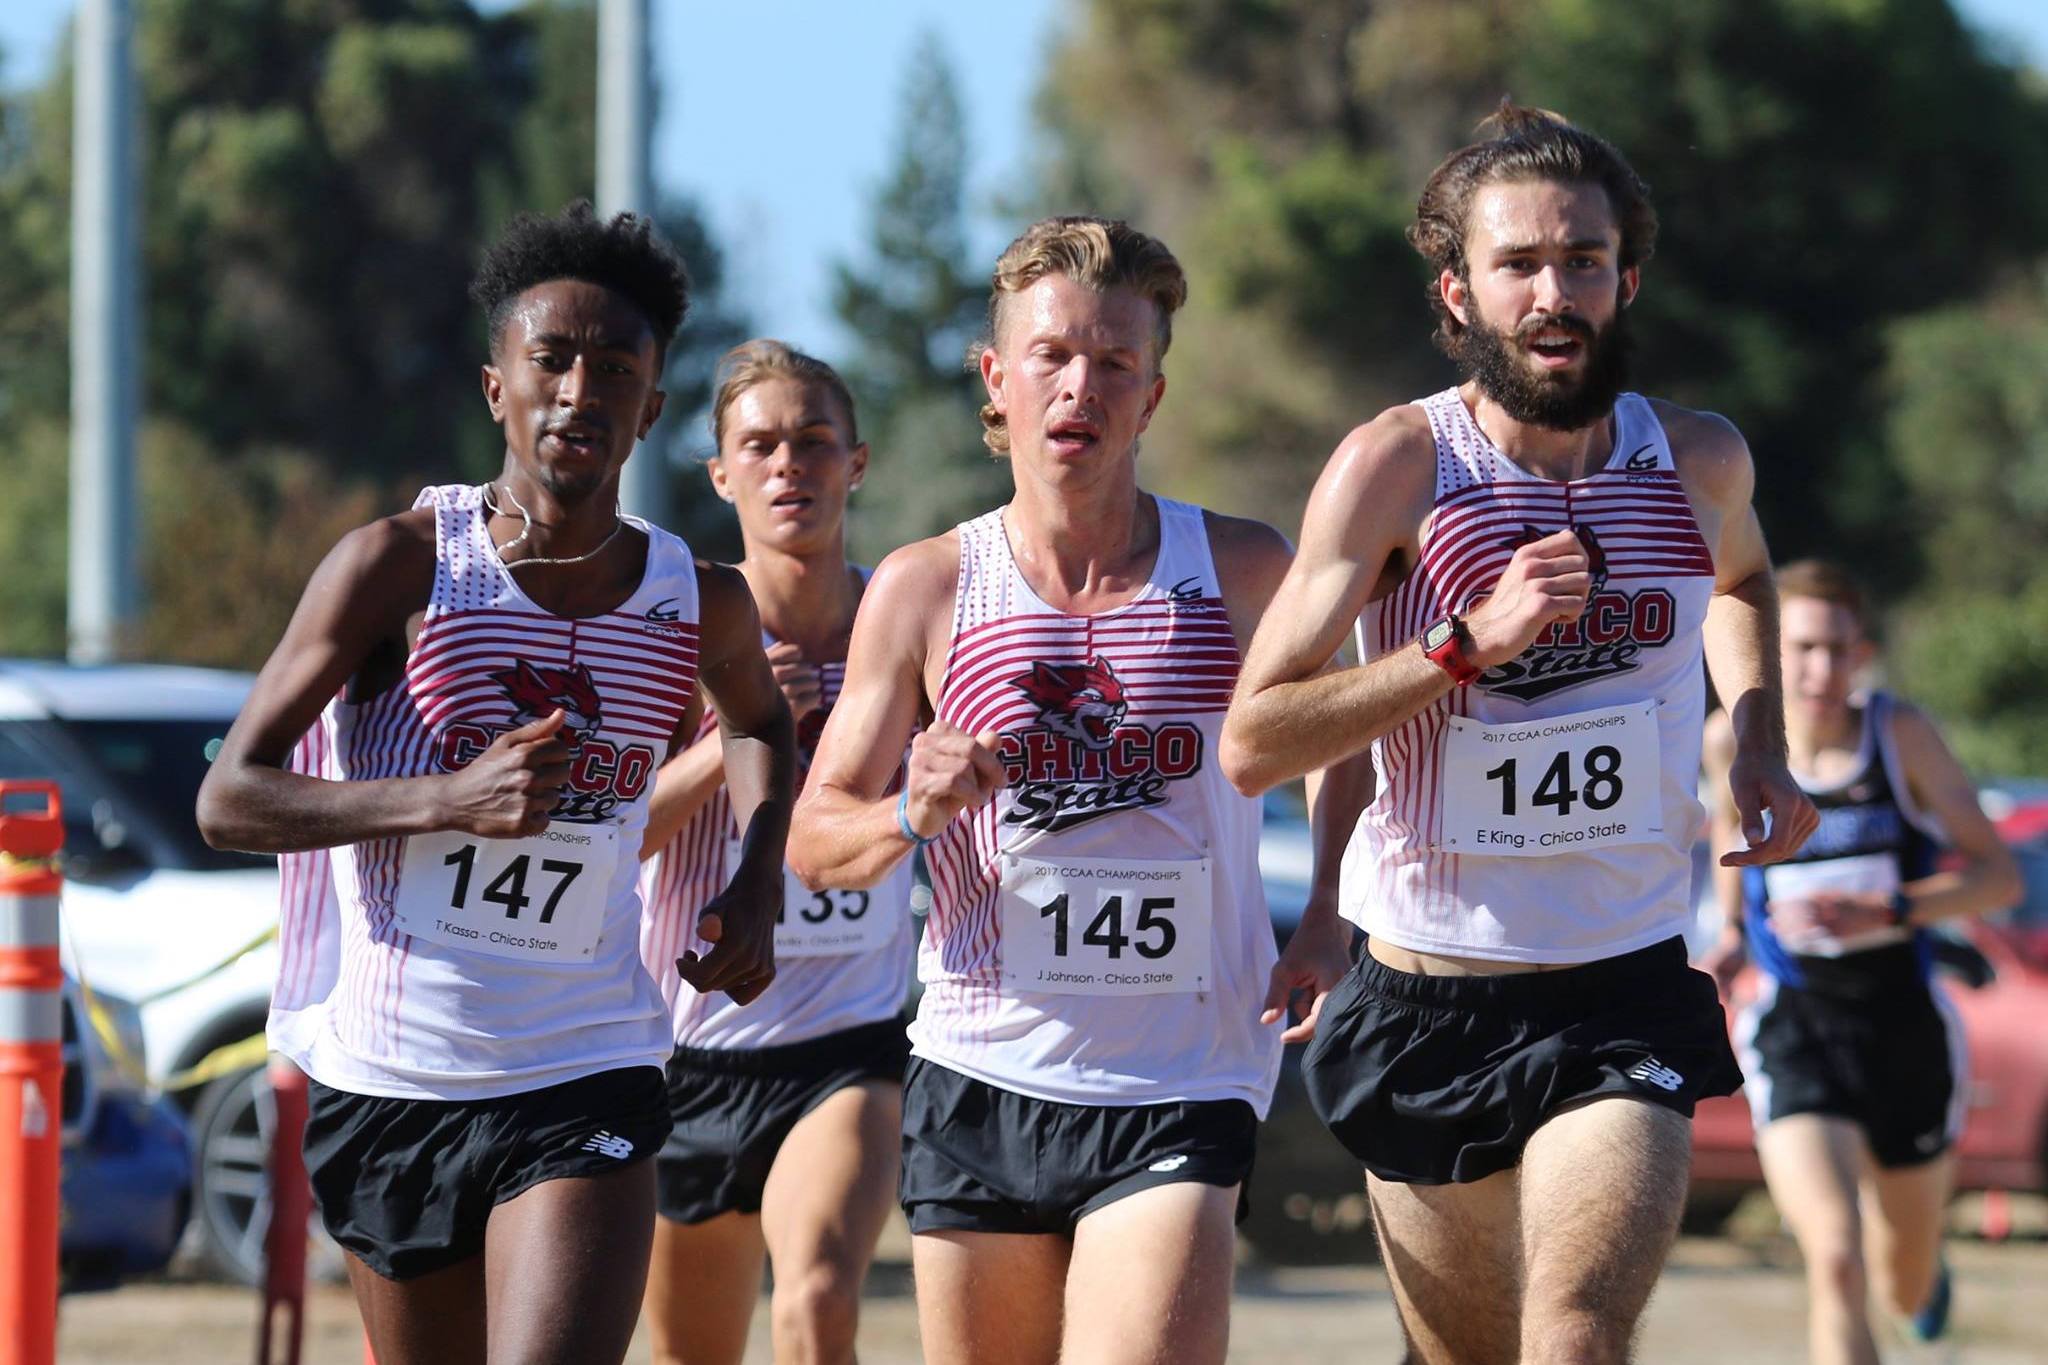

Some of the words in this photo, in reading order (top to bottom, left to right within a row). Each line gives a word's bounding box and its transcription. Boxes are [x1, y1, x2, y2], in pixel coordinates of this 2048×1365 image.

[1482, 731, 1505, 743] 2017
[1508, 730, 1540, 743] CCAA
[1543, 715, 1626, 737] CHAMPIONSHIPS
[436, 720, 654, 800] CCO
[1486, 745, 1624, 816] 148
[1003, 771, 1168, 825] State
[1477, 829, 1486, 844] E
[1490, 830, 1525, 848] King
[1539, 831, 1585, 847] Chico
[1587, 823, 1627, 838] State
[443, 843, 584, 924] 147
[1035, 867, 1058, 877] 2017
[1060, 867, 1094, 878] CCAA
[1096, 868, 1182, 881] CHAMPIONSHIPS
[434, 920, 443, 930] T
[443, 922, 479, 940] Kassa
[489, 931, 526, 948] Chico
[528, 936, 558, 951] State
[1040, 893, 1177, 959] 145
[1037, 970, 1043, 981] J
[1046, 971, 1094, 984] Johnson
[1104, 973, 1141, 985] Chico
[1143, 972, 1173, 984] State
